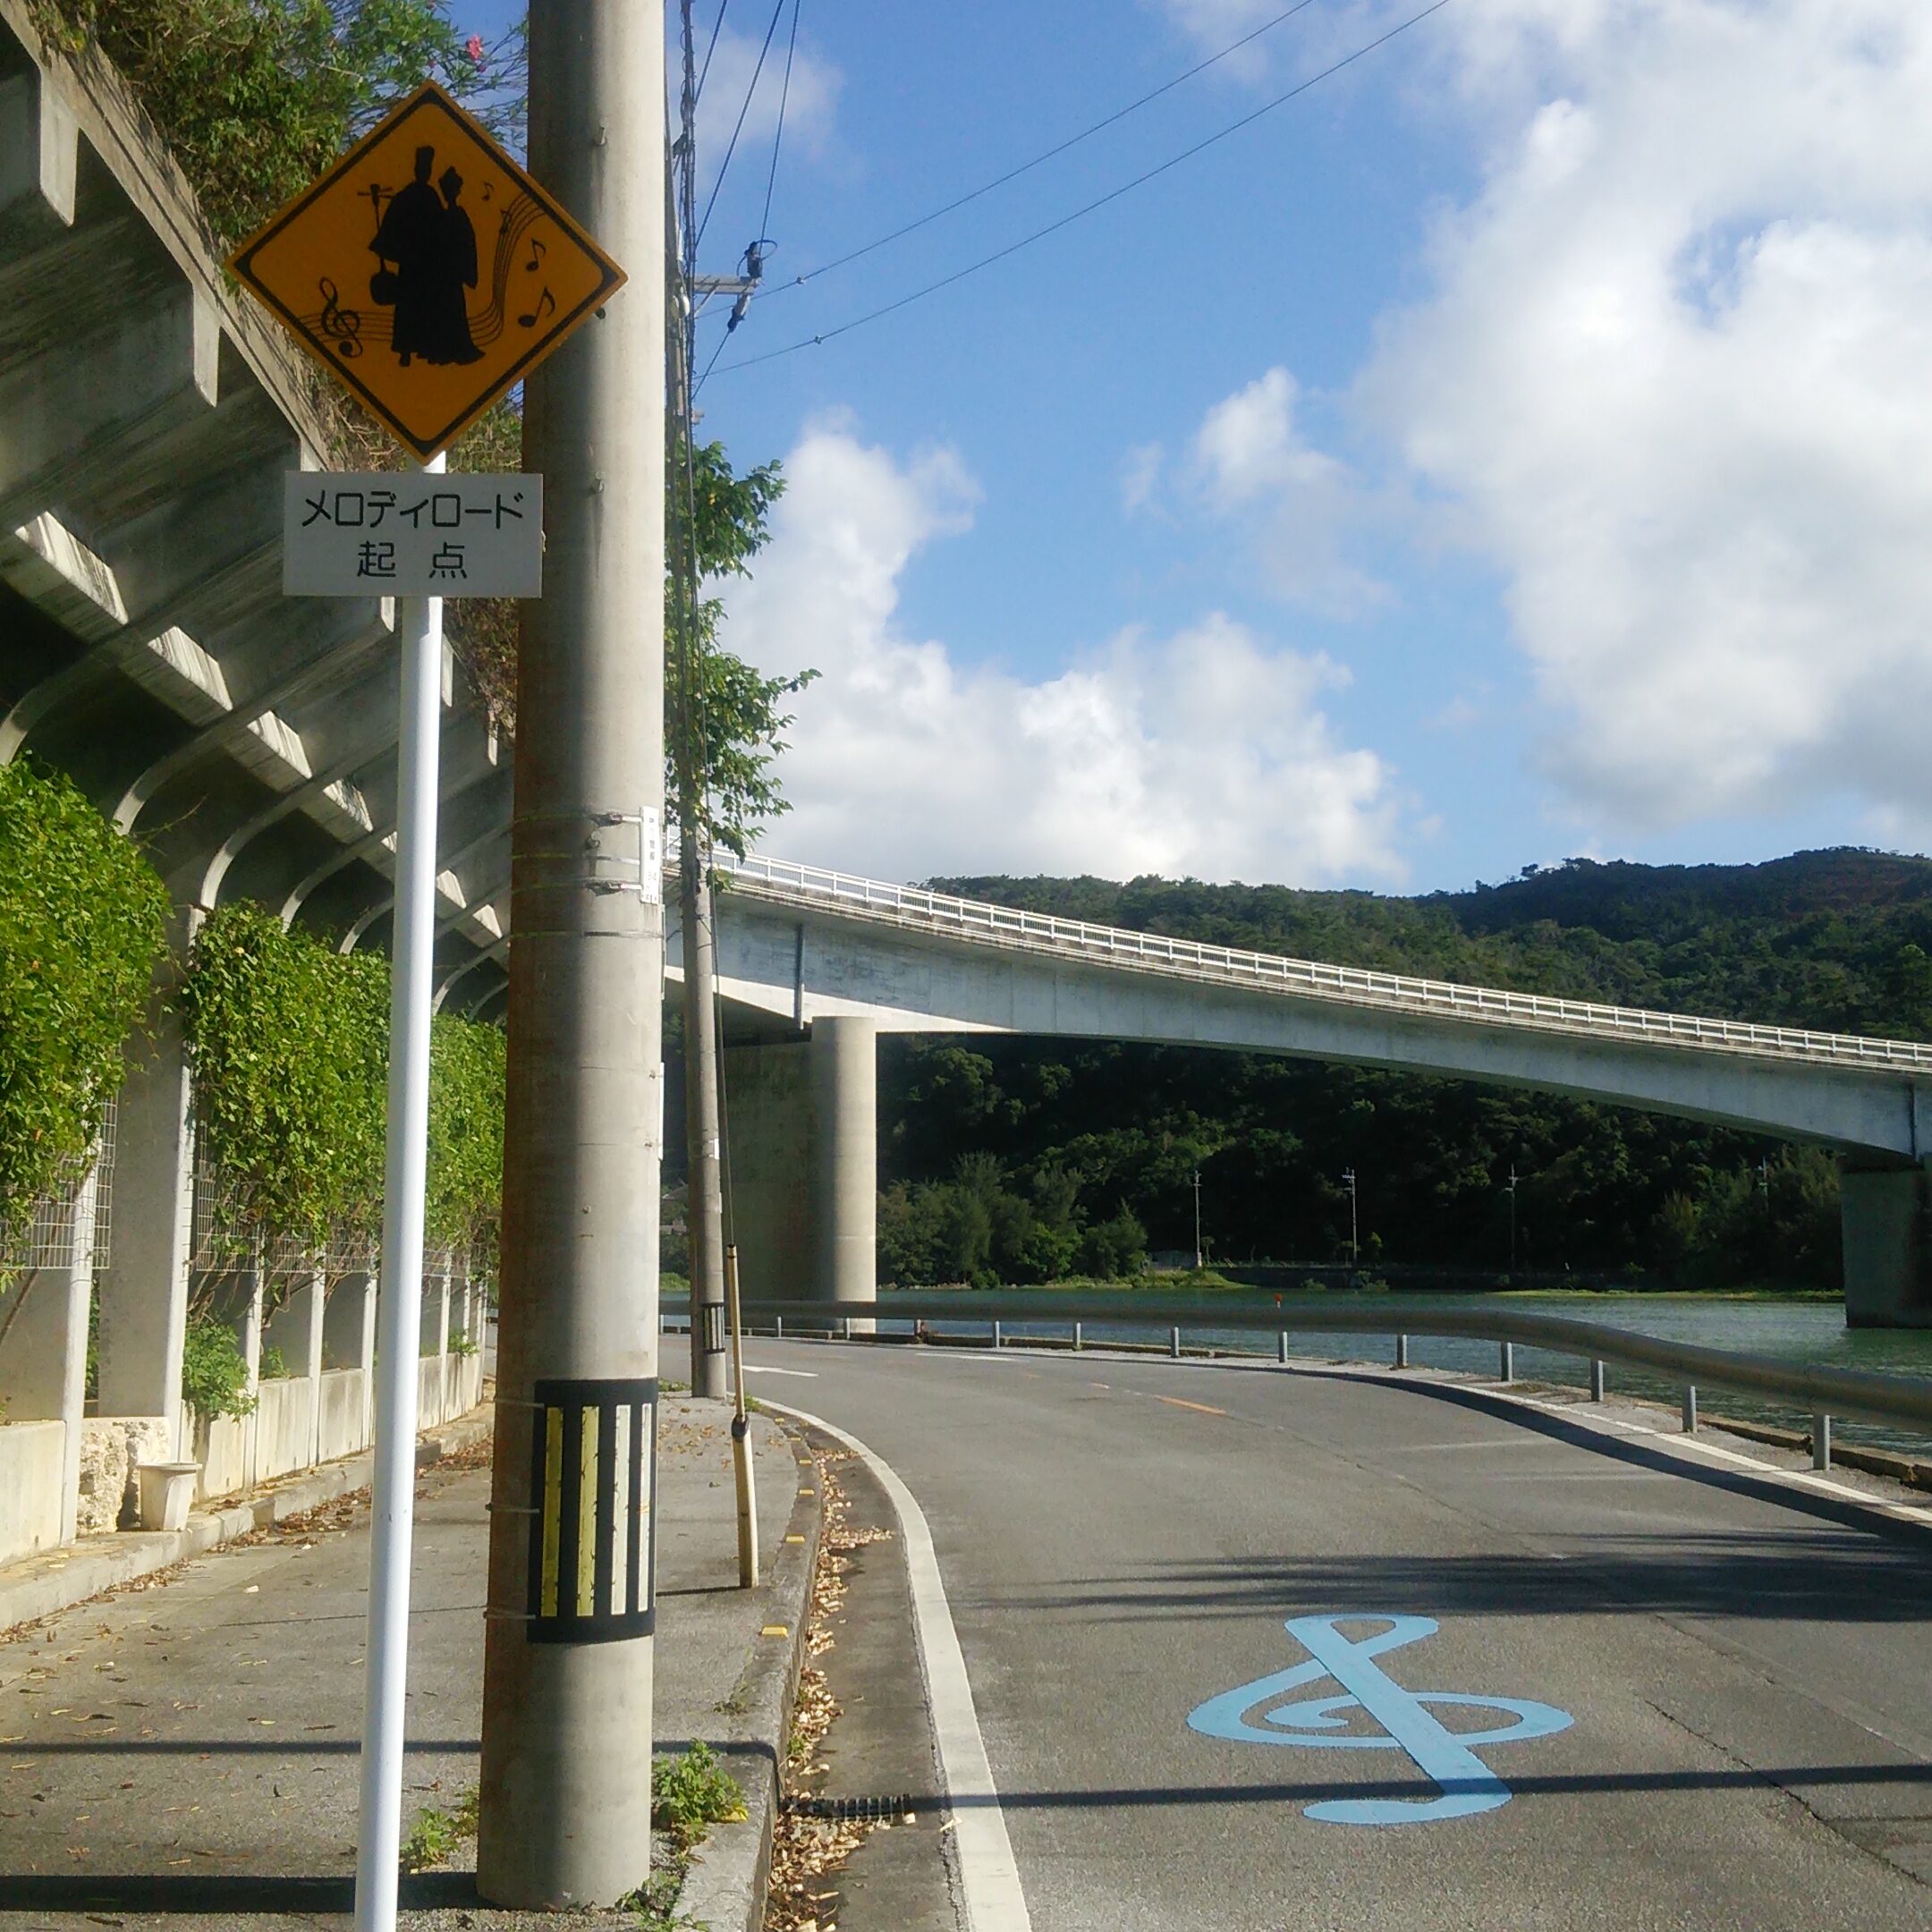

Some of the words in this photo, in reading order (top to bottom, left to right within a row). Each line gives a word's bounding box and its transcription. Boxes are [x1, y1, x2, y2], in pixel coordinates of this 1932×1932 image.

[301, 490, 523, 530] メロディロード
